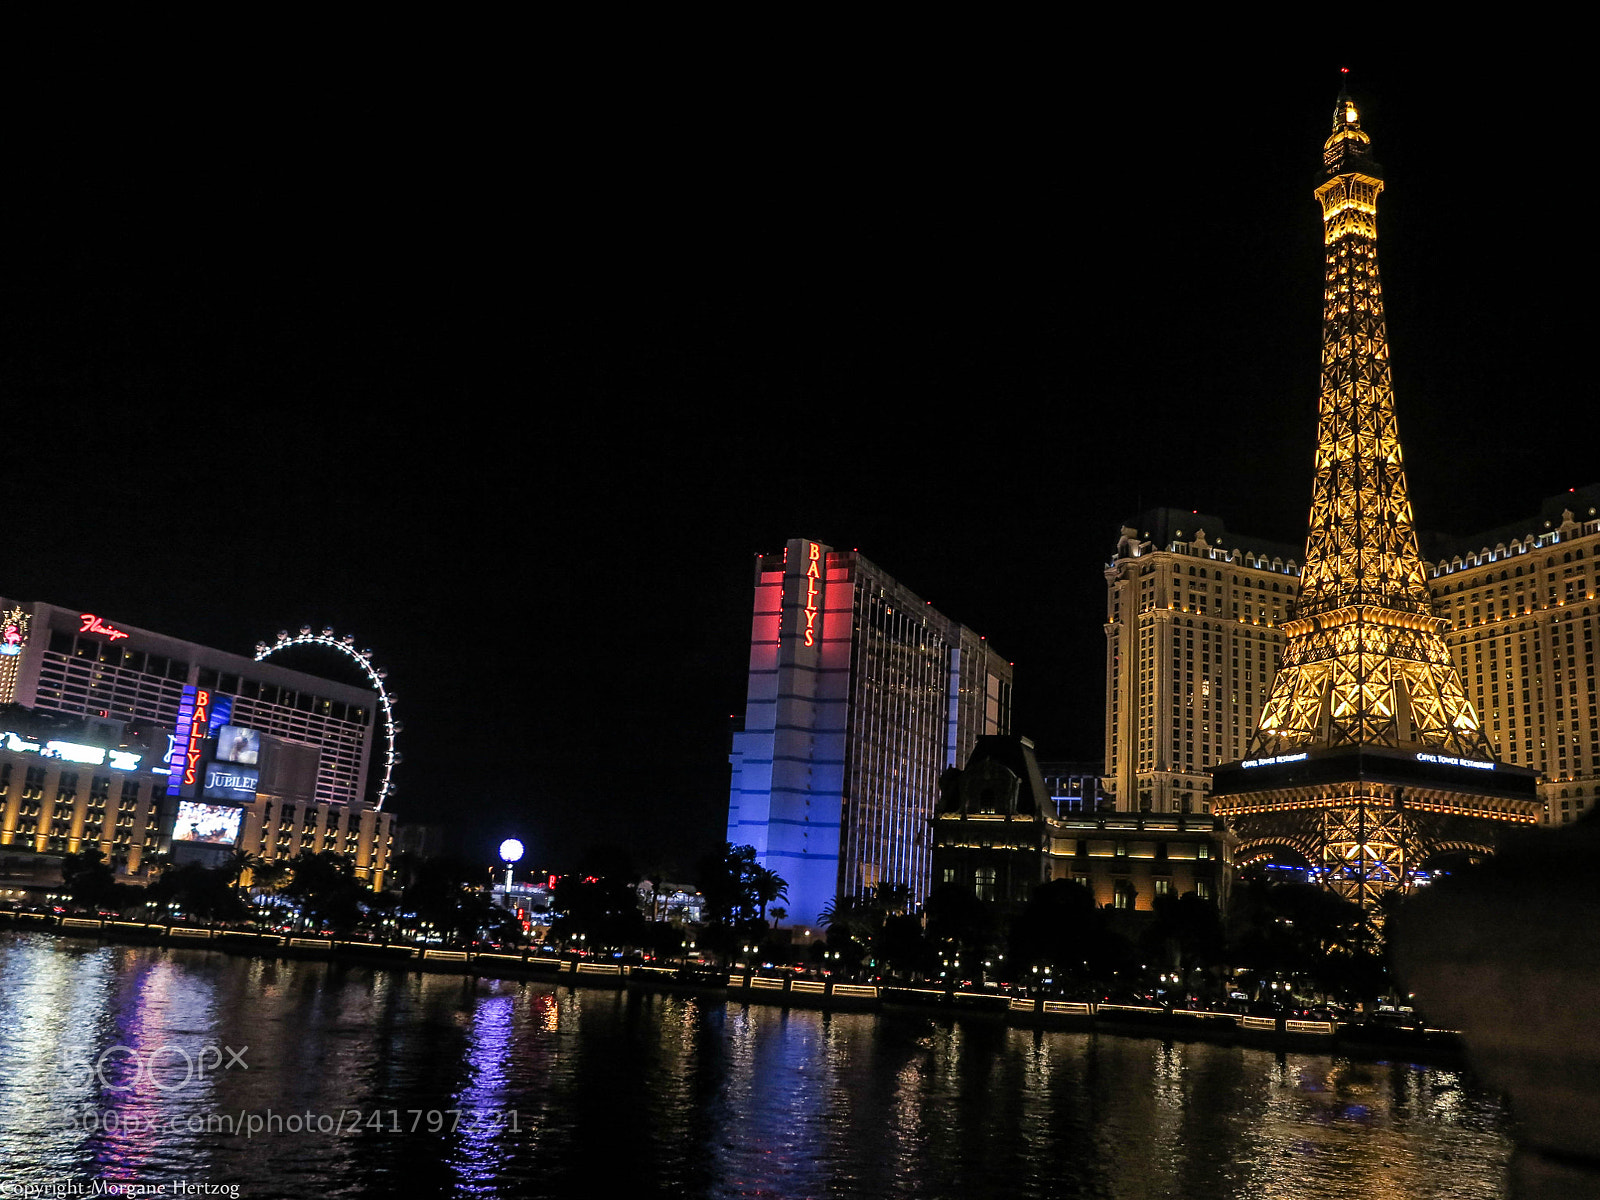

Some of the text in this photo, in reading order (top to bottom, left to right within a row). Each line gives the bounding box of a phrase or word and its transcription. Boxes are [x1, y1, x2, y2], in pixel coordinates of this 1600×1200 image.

[804, 543, 820, 647] BALLYS
[184, 690, 209, 784] BALLYS
[204, 772, 258, 790] JUBILEE
